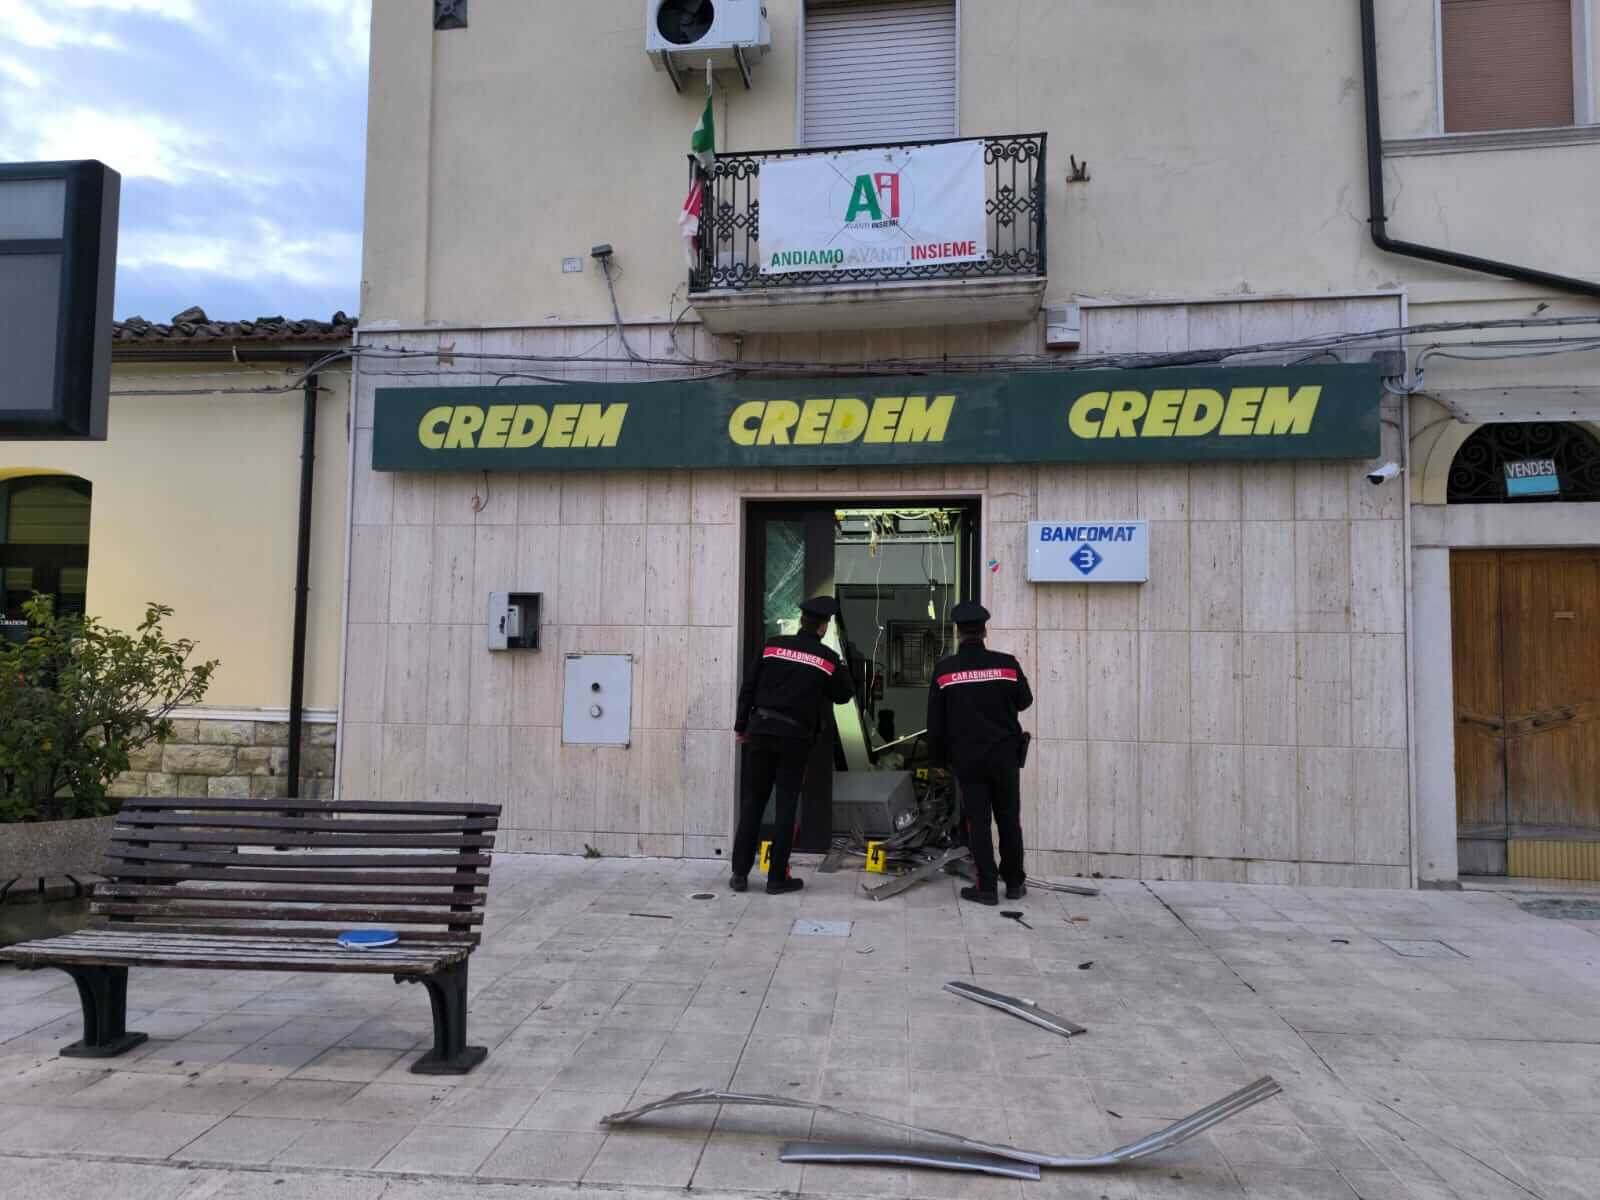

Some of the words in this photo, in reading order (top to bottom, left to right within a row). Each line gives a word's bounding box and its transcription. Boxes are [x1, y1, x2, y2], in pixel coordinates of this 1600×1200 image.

[771, 248, 844, 267] ANDIAMO
[847, 246, 905, 265] AVANTI
[911, 240, 976, 260] INSIEME
[728, 395, 955, 447] CREDEM
[1068, 385, 1323, 440] CREDEM
[418, 403, 628, 449] CREDEM
[1506, 459, 1556, 477] VENDESI
[1040, 526, 1136, 542] BANCOMAT
[776, 646, 824, 667] CARABINIERI
[951, 668, 1002, 682] CARABINIERI
[871, 847, 879, 865] 4
